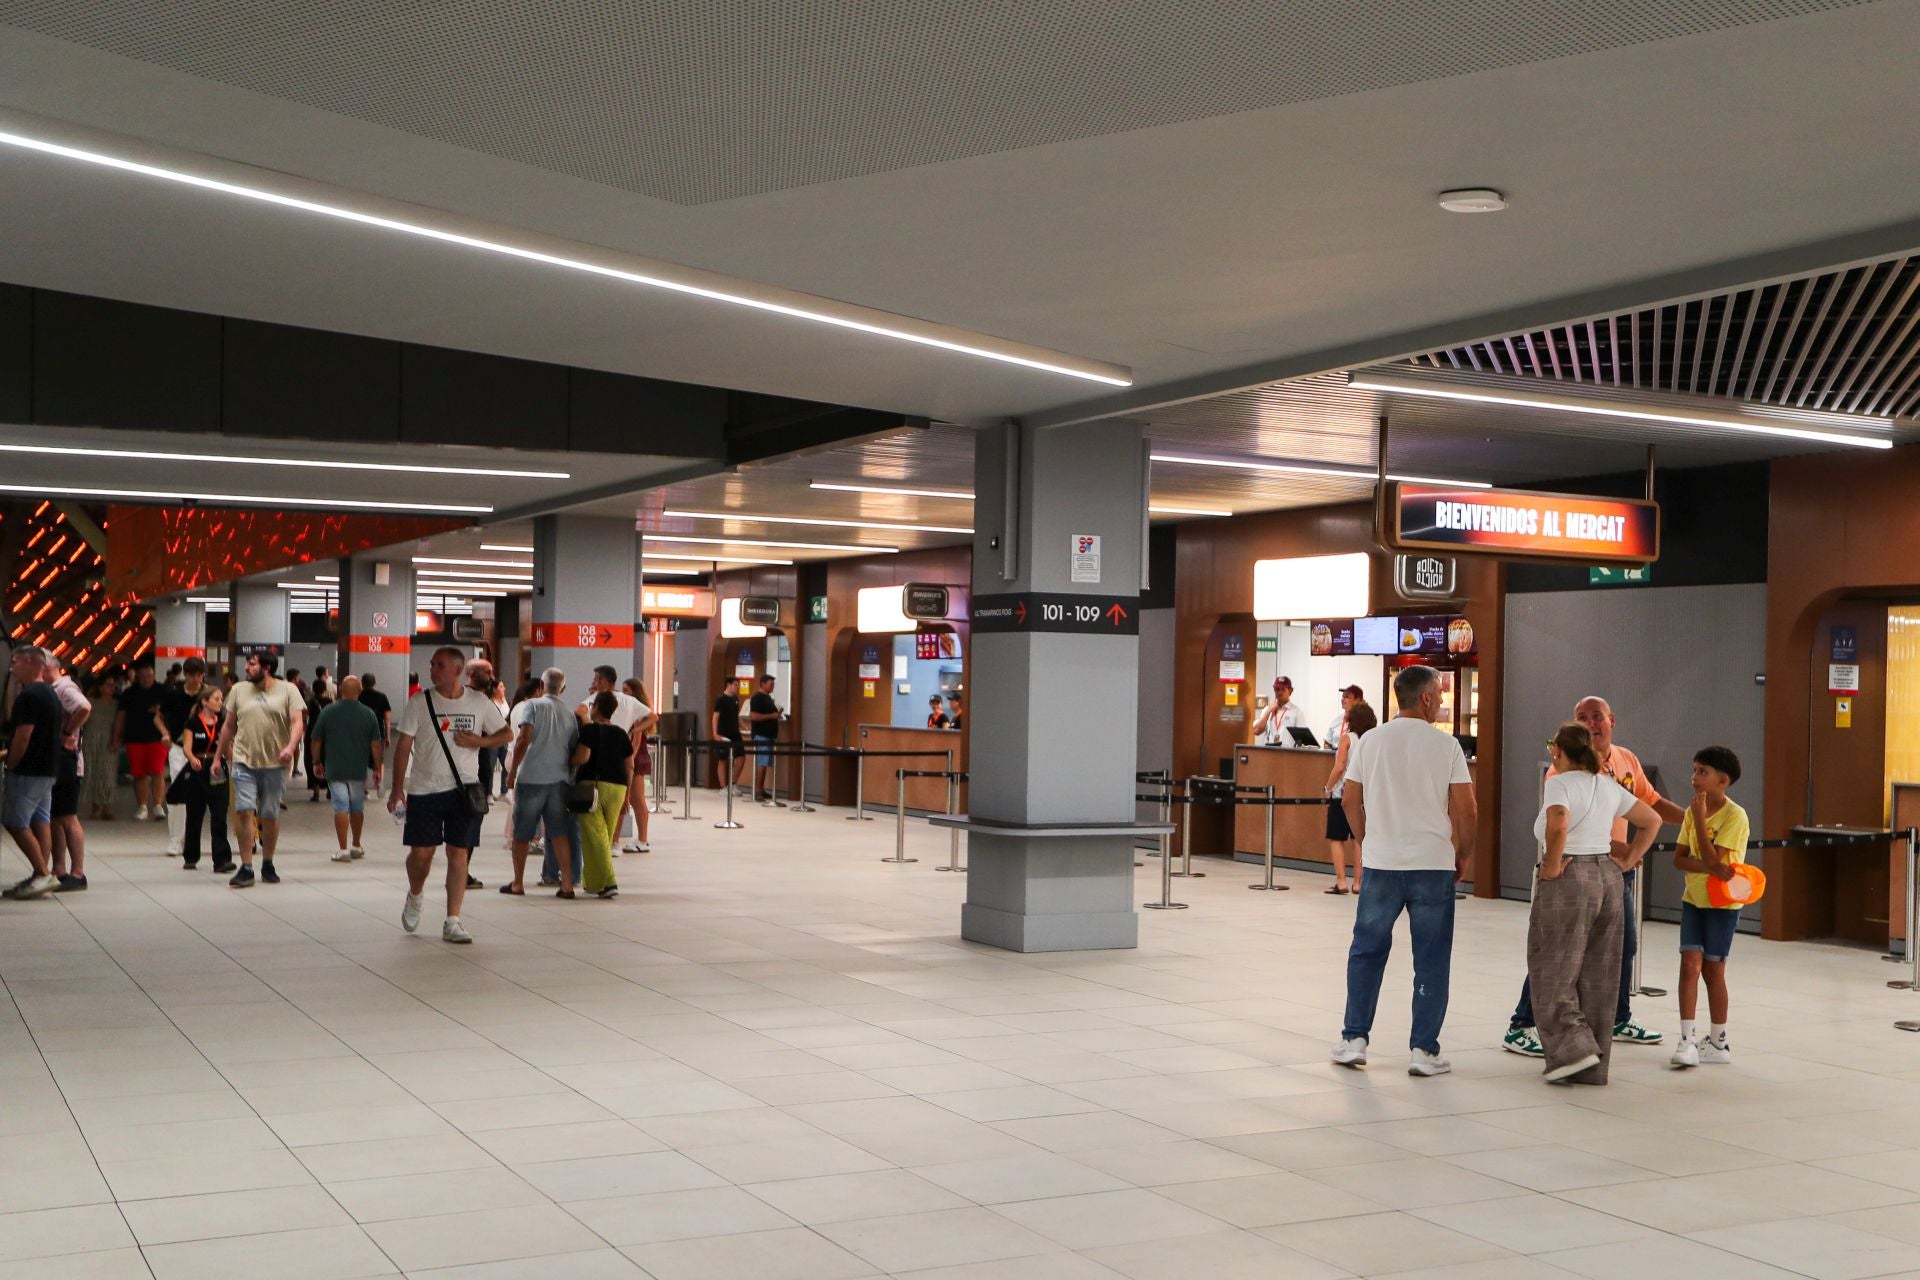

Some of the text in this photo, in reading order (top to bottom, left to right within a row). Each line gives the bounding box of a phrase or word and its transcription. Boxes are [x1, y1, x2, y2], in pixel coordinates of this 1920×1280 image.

[1435, 501, 1626, 542] BIENVENIDOS AL MERCAT
[1416, 557, 1444, 574] ADICTA
[1416, 572, 1444, 588] ADICTO
[1043, 604, 1063, 621] 101
[1075, 605, 1100, 622] 109
[578, 625, 596, 636] 108
[368, 636, 382, 644] 107
[578, 635, 596, 646] 109
[1257, 640, 1276, 648] ALIDA
[368, 643, 382, 652] 108
